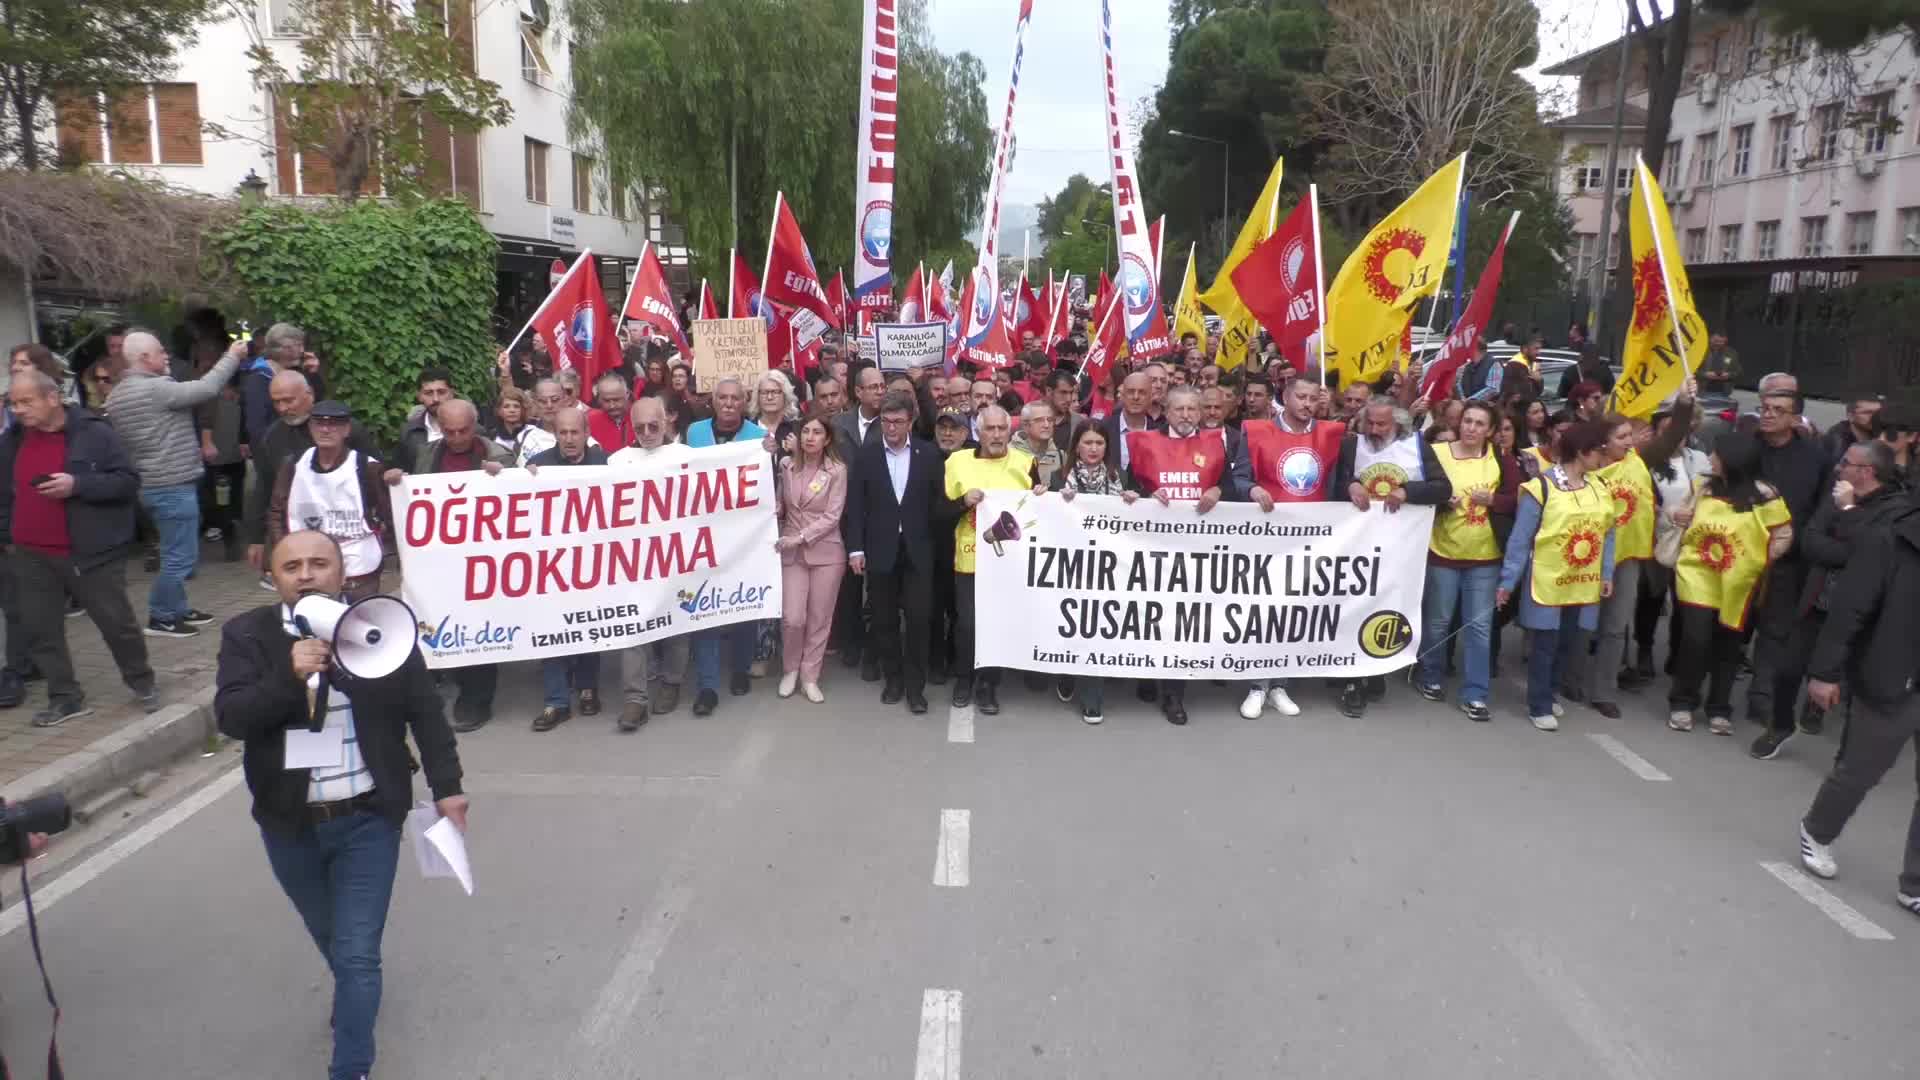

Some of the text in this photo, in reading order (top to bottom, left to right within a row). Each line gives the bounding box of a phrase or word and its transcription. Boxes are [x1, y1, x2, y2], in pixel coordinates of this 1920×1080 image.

[887, 332, 937, 341] KARANLIĞA
[897, 341, 927, 349] TESLİM
[1159, 471, 1200, 484] EMEK
[405, 463, 760, 547] ÖĞRETMENİME
[1159, 487, 1202, 499] YLEM
[1082, 514, 1333, 538] #öğretmenimedokunma
[464, 526, 718, 601] DOKUNMA
[1026, 535, 1382, 597] İZMİR ATATÜRK LİSESİ
[562, 603, 639, 626] VELİDER
[1057, 598, 1341, 644] SUSAR MI SANDIN
[531, 611, 673, 648] İZMİR ŞUBELERİ
[1032, 645, 1356, 672] İzmir Atatürk Lisesi Öğrenci Velileri
